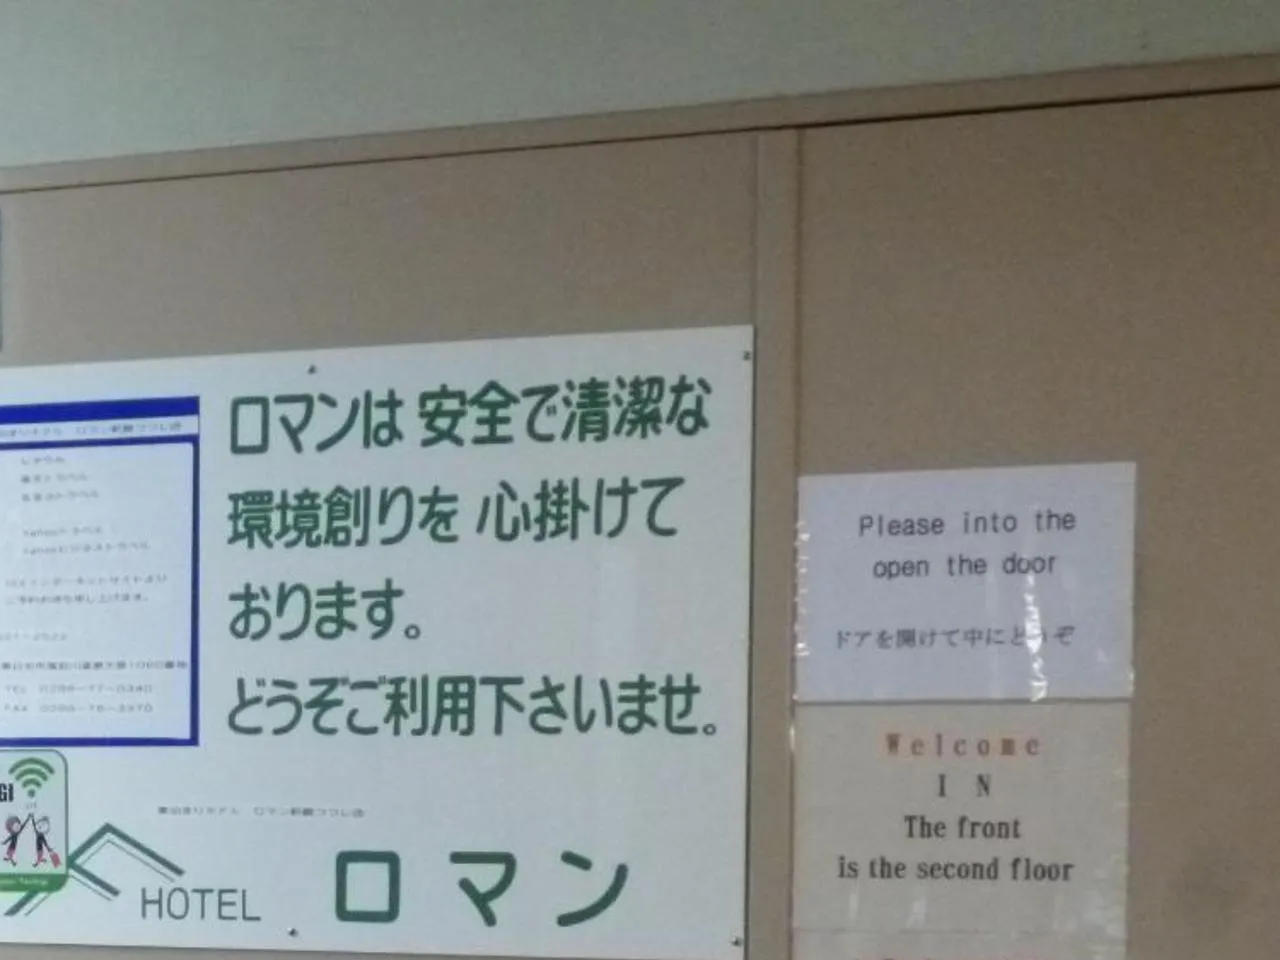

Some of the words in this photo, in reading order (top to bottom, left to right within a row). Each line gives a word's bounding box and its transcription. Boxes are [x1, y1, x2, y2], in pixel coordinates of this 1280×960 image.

[229, 388, 405, 455] ロマンは
[418, 374, 712, 448] 安全で清潔な
[227, 486, 460, 549] 環境創りを
[475, 477, 686, 543] 心掛けて
[858, 514, 945, 538] Please
[963, 511, 1017, 534] into
[1036, 509, 1077, 532] the
[873, 558, 930, 581] open
[947, 553, 987, 576] the
[1002, 553, 1057, 576] door
[228, 578, 421, 641] おります。
[227, 673, 718, 737] どうぞご利用下さいませ。
[904, 815, 946, 839] The
[958, 815, 1021, 839] front
[336, 850, 629, 927] ロマン
[838, 857, 858, 879] is
[869, 857, 906, 879] the
[916, 857, 999, 881] second
[1010, 858, 1075, 882] floor
[140, 887, 262, 922] HOTEL
